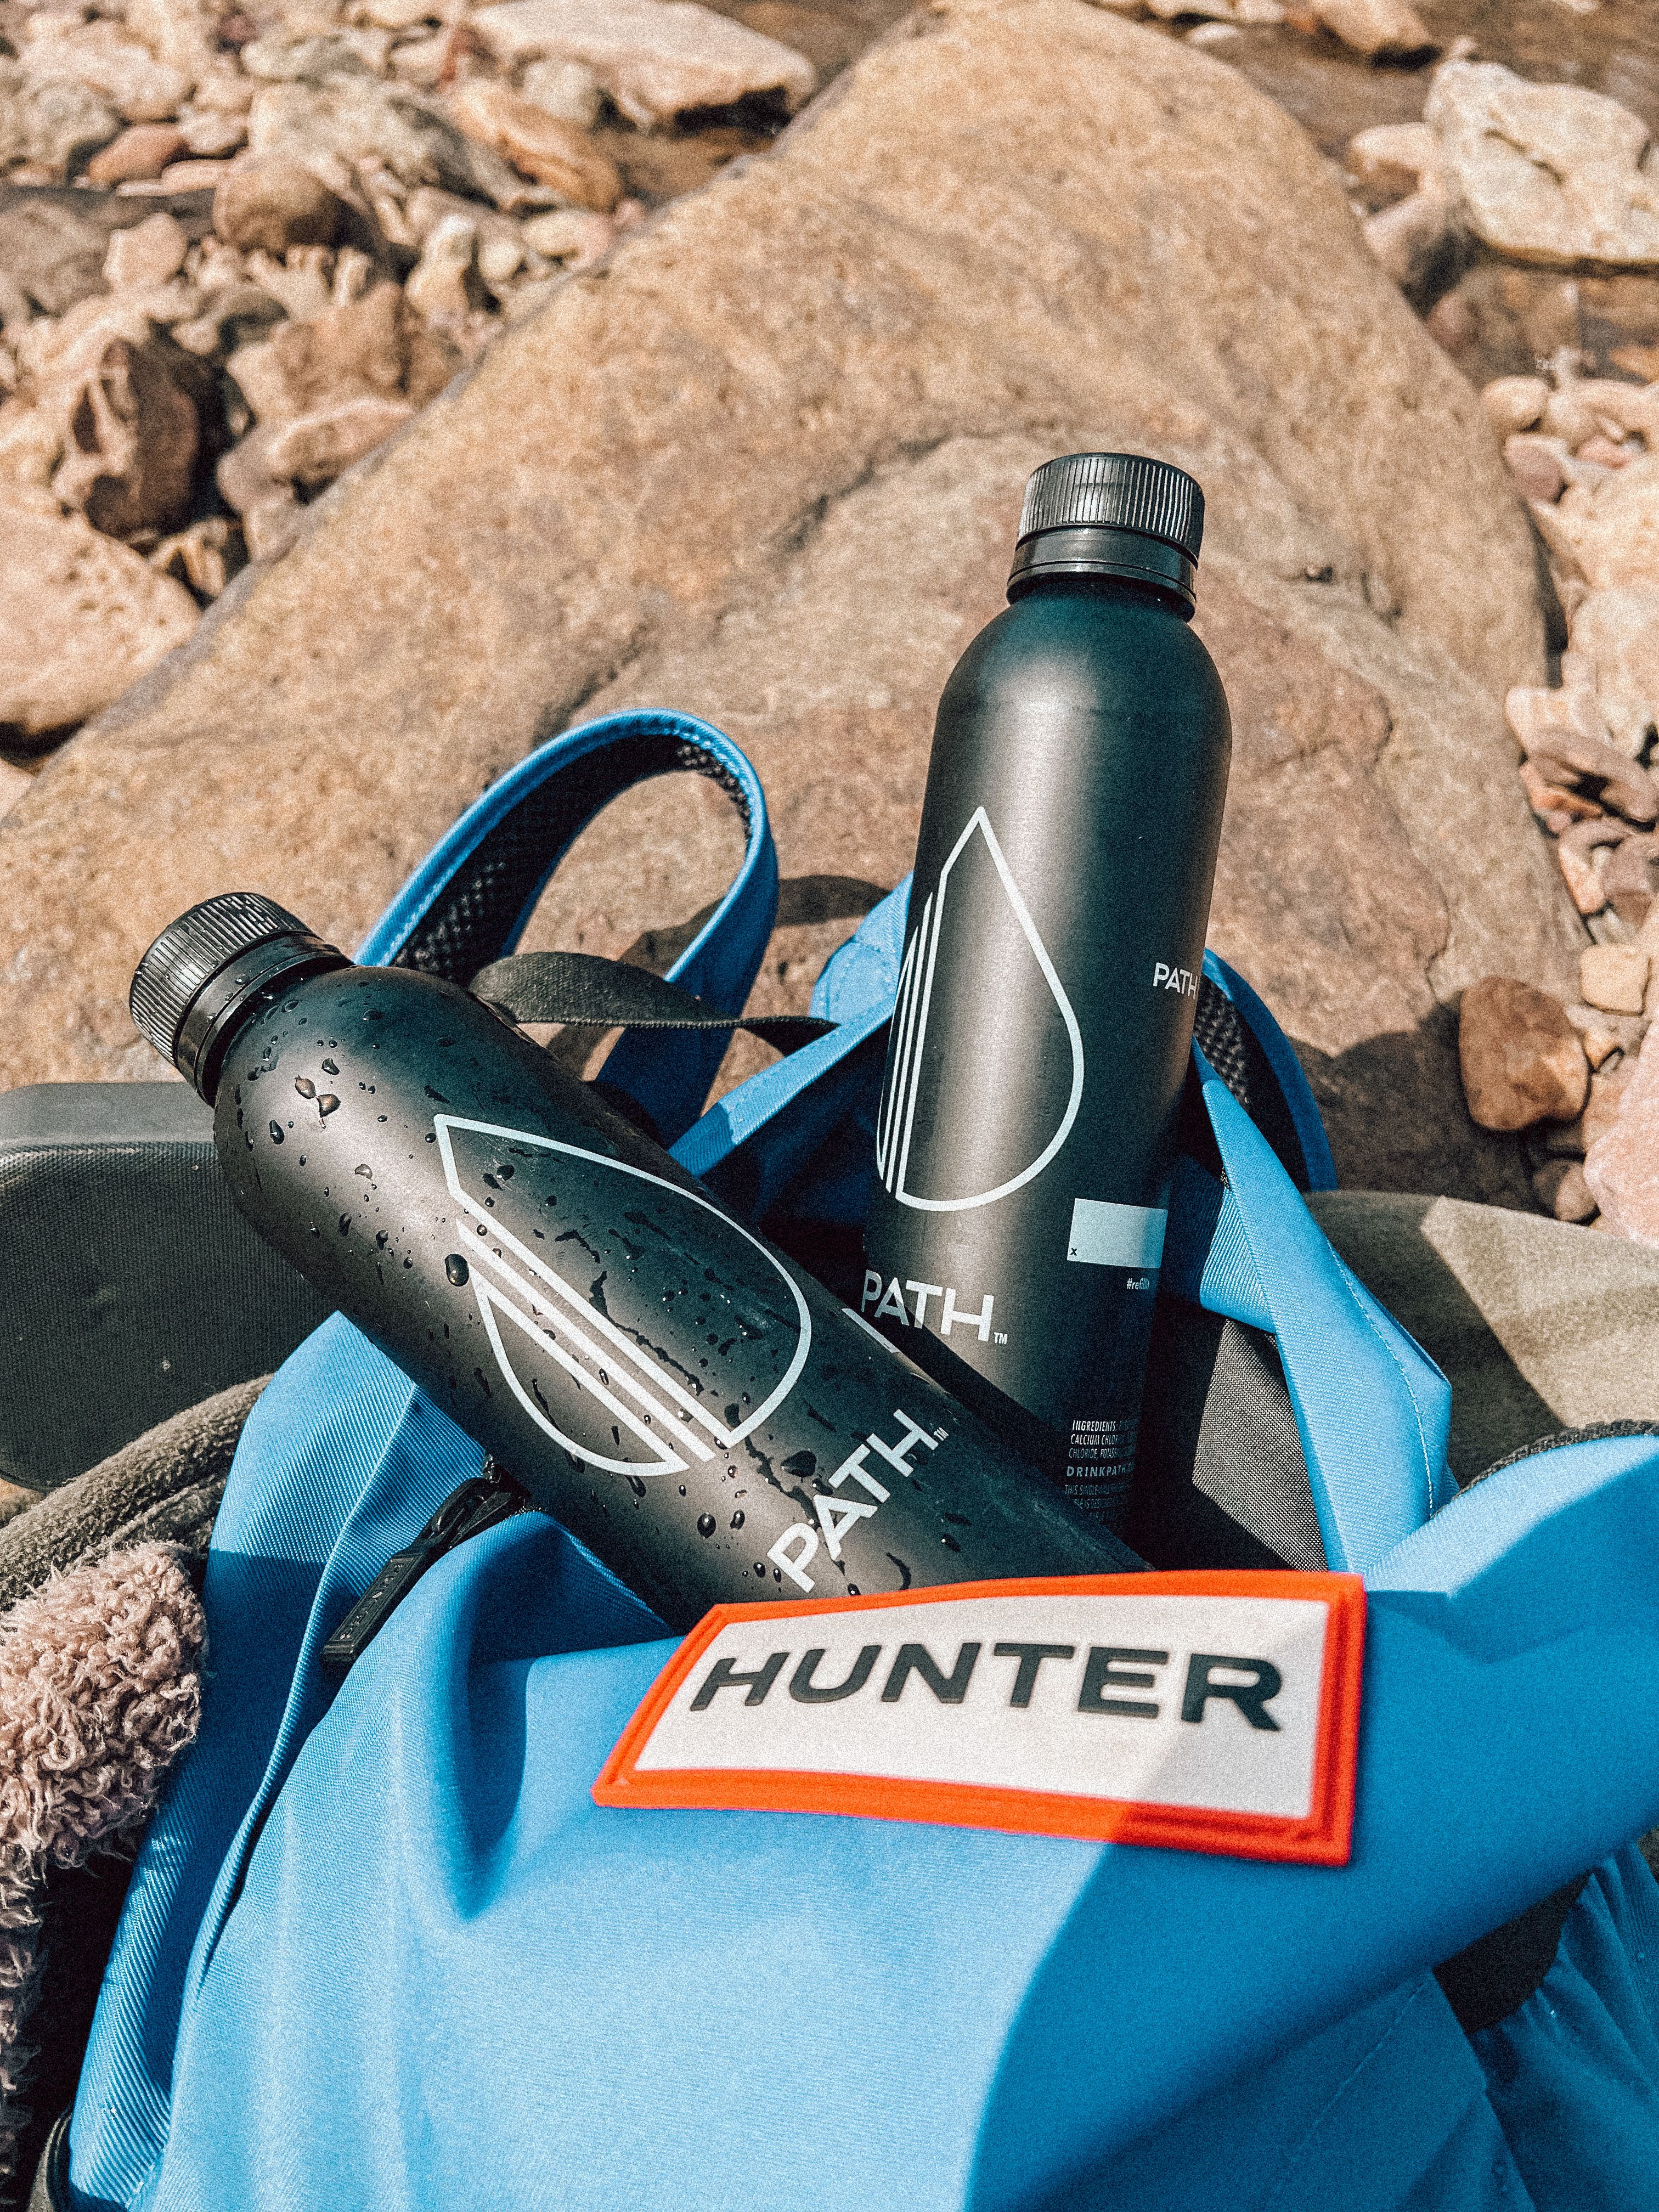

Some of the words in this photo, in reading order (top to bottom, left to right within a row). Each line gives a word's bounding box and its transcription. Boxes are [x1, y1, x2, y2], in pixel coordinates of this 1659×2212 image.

[1153, 962, 1198, 999] PATH
[861, 1269, 995, 1342] PATH
[1070, 1434, 1099, 1445] CALCIUM
[766, 1409, 939, 1593] PATH
[689, 1642, 1283, 1732] HUNTER
